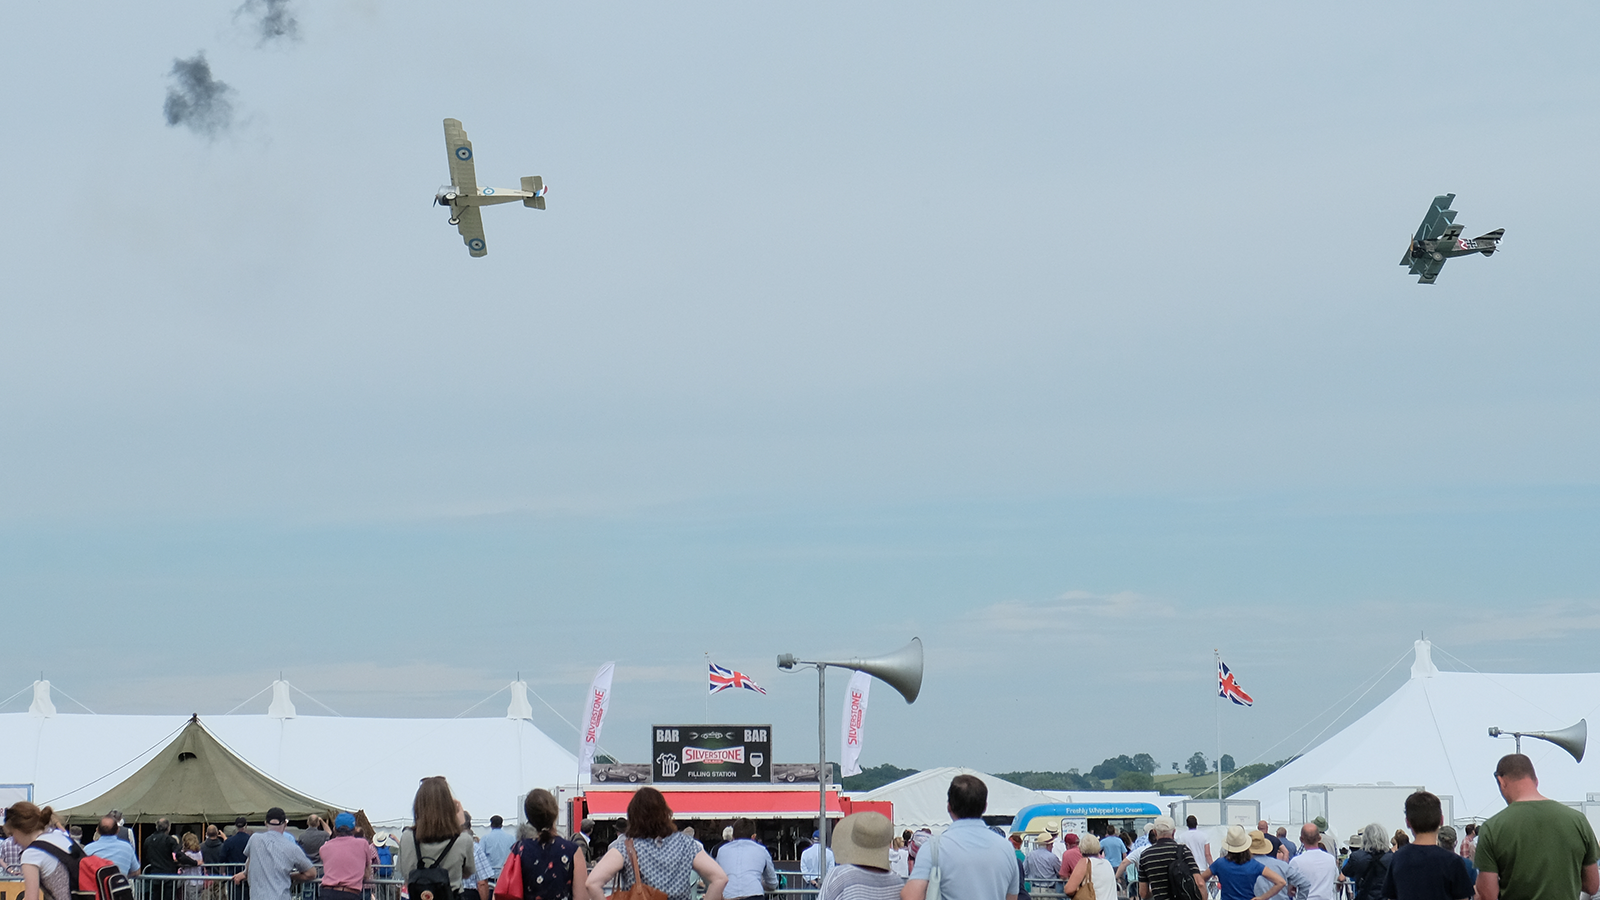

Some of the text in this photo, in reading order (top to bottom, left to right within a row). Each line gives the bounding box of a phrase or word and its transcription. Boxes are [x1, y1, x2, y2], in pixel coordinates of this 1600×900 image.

[585, 689, 605, 744] SILVERSTONE
[847, 691, 862, 745] SILVERSTONE
[656, 729, 767, 742] BAR BAR
[685, 748, 742, 761] SILVERSTONE
[1066, 807, 1088, 815] Freshly
[1089, 807, 1114, 815] Whipped
